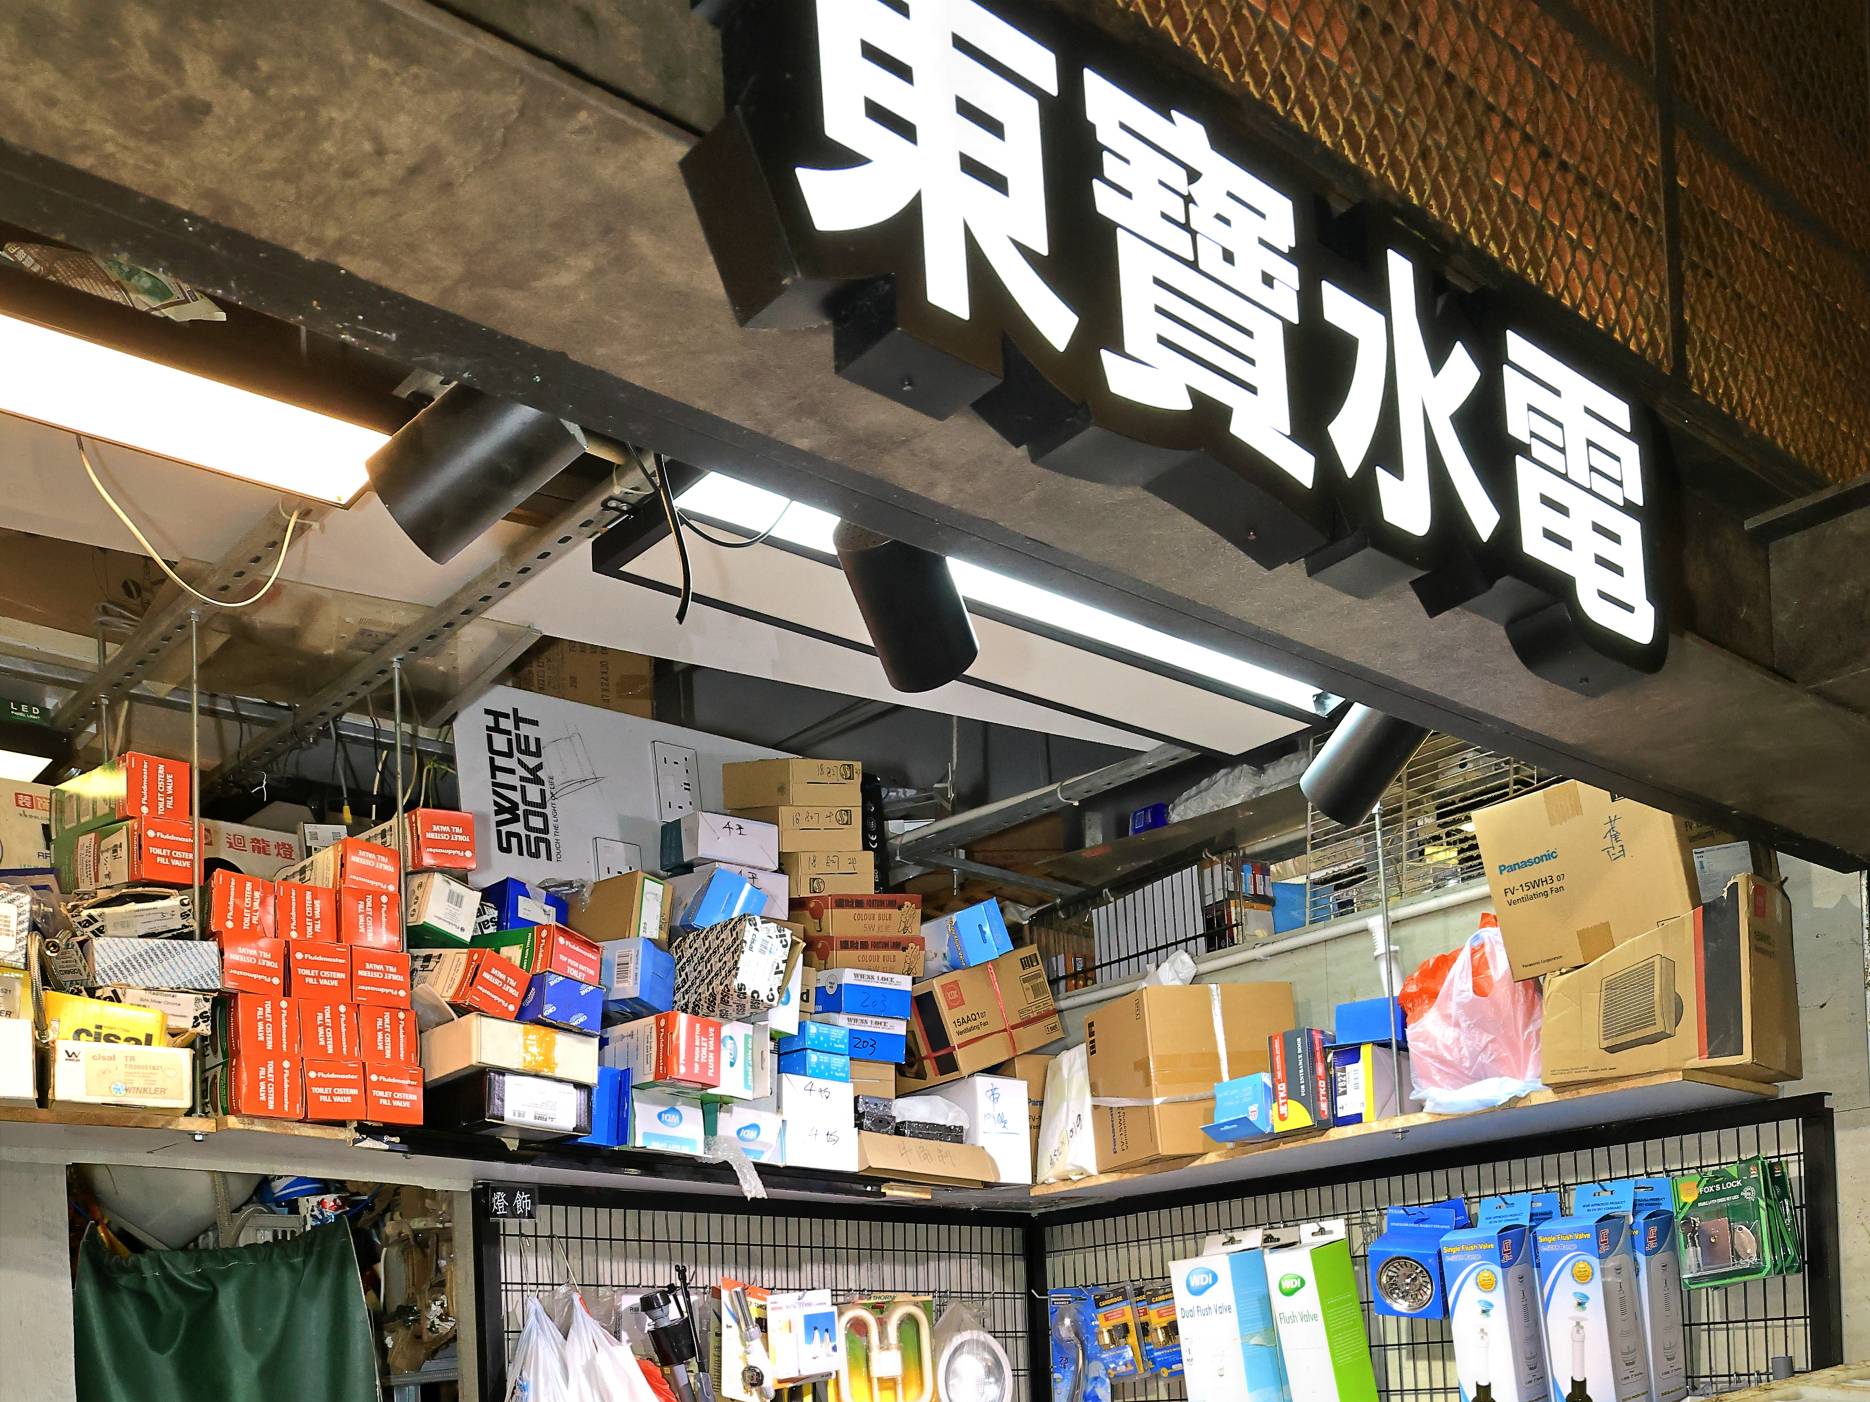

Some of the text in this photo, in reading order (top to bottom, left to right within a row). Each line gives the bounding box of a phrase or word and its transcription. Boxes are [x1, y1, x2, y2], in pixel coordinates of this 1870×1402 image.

[795, 0, 1658, 645] 東寶水電
[11, 702, 40, 714] LED
[484, 708, 524, 856] SWITCH
[512, 707, 552, 862] SOCKET
[432, 824, 450, 832] VALVE
[426, 832, 470, 842] TOILET CISTERN
[149, 847, 193, 860] TOILET CISTER
[426, 847, 465, 857] Fluidmaster
[171, 859, 191, 868] VALVE
[1498, 849, 1559, 876] Panasonic
[1504, 874, 1565, 897] FV-15WH3 07
[227, 878, 236, 920] Fluidmaster
[252, 891, 260, 912] VALVE
[1507, 885, 1565, 907] Ventilating Fan
[243, 882, 252, 930] TOILET CISTERN
[853, 913, 873, 921] COLOUR
[304, 954, 346, 963] Fluidmaster
[857, 955, 878, 963] COLOUR
[365, 962, 381, 970] VALVE
[297, 969, 346, 979] TOILET CISTERN
[358, 970, 404, 981] TOILET CISTERN
[490, 968, 517, 987] FILL VALVE
[566, 967, 586, 981] TOILET
[319, 978, 338, 986] VALVE
[482, 971, 519, 998] TOILET CISTERN
[357, 984, 398, 995] Fluidmaster
[953, 1012, 981, 1028] 15AAQ1
[339, 1012, 347, 1055] Fluidmaster
[956, 1023, 979, 1037] Ventilating
[326, 1027, 334, 1054] CISTERN
[317, 1071, 358, 1080] Fluidmaster
[1297, 1053, 1305, 1085] ENTRANCE
[379, 1075, 418, 1086] Fluidmaster
[1338, 1072, 1347, 1096] Y827
[125, 1087, 167, 1095] WINKLER
[311, 1087, 358, 1096] TOILET CISTERN
[372, 1089, 417, 1101] TOILET CISTERN
[1318, 1080, 1327, 1115] JETKO
[394, 1100, 411, 1108] VALVE
[1278, 1083, 1288, 1117] JETKO
[1700, 1180, 1742, 1194] FOX'S LOCK
[492, 1191, 530, 1216] 燈飾
[1538, 1235, 1556, 1244] Single
[1558, 1233, 1574, 1241] Flush
[1443, 1246, 1460, 1254] Single
[1189, 1273, 1213, 1288] WDI
[1281, 1279, 1301, 1290] WDI
[1099, 1296, 1123, 1306] CAMBRIDGE
[1180, 1302, 1232, 1319] Dual Flush Valve
[1279, 1311, 1319, 1325] Flush Valve
